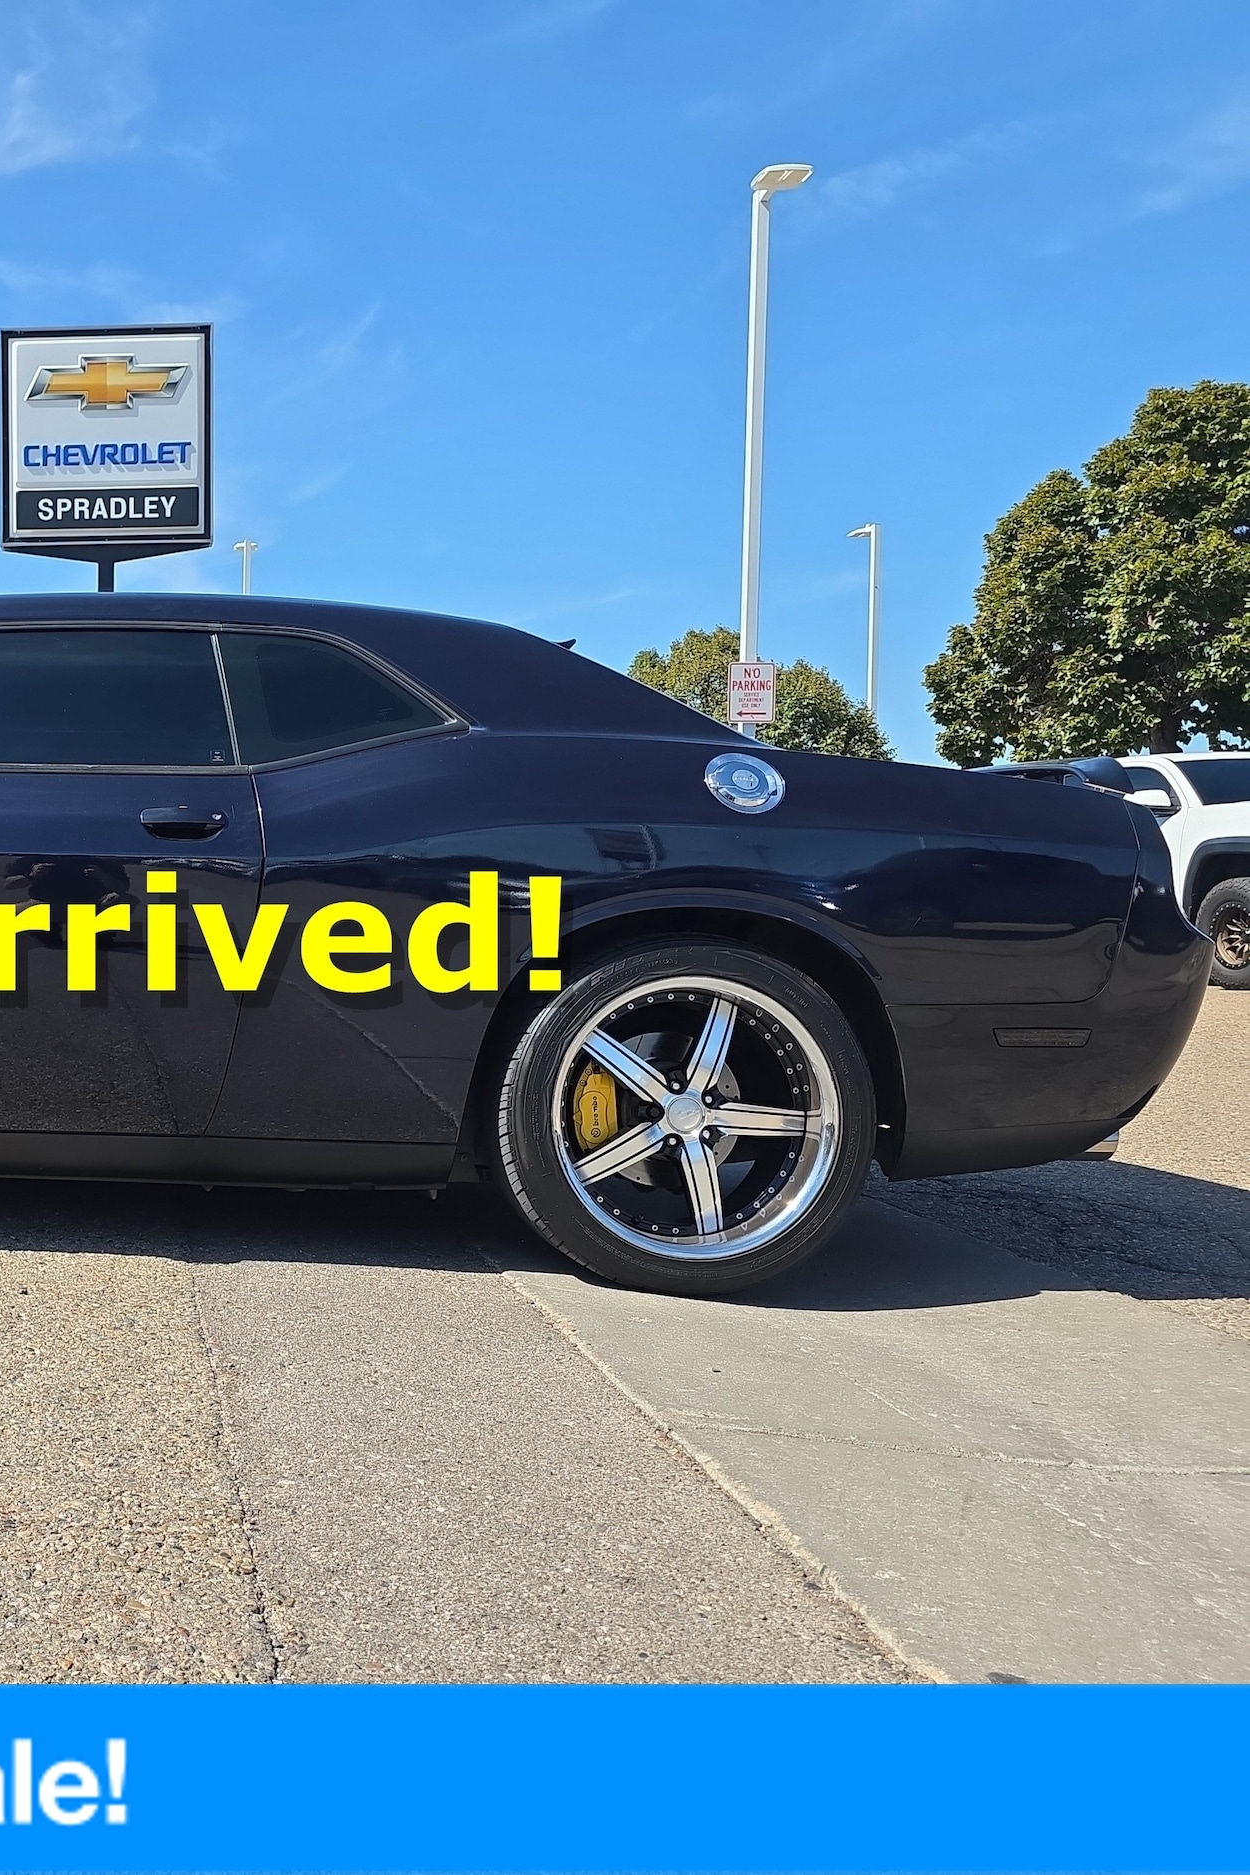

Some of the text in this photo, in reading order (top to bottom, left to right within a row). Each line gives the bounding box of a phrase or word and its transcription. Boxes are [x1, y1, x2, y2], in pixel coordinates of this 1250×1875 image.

[23, 441, 192, 467] CHEVROLET
[37, 496, 177, 521] SPRADLEY
[744, 668, 760, 679] NO
[732, 680, 772, 691] PARKING
